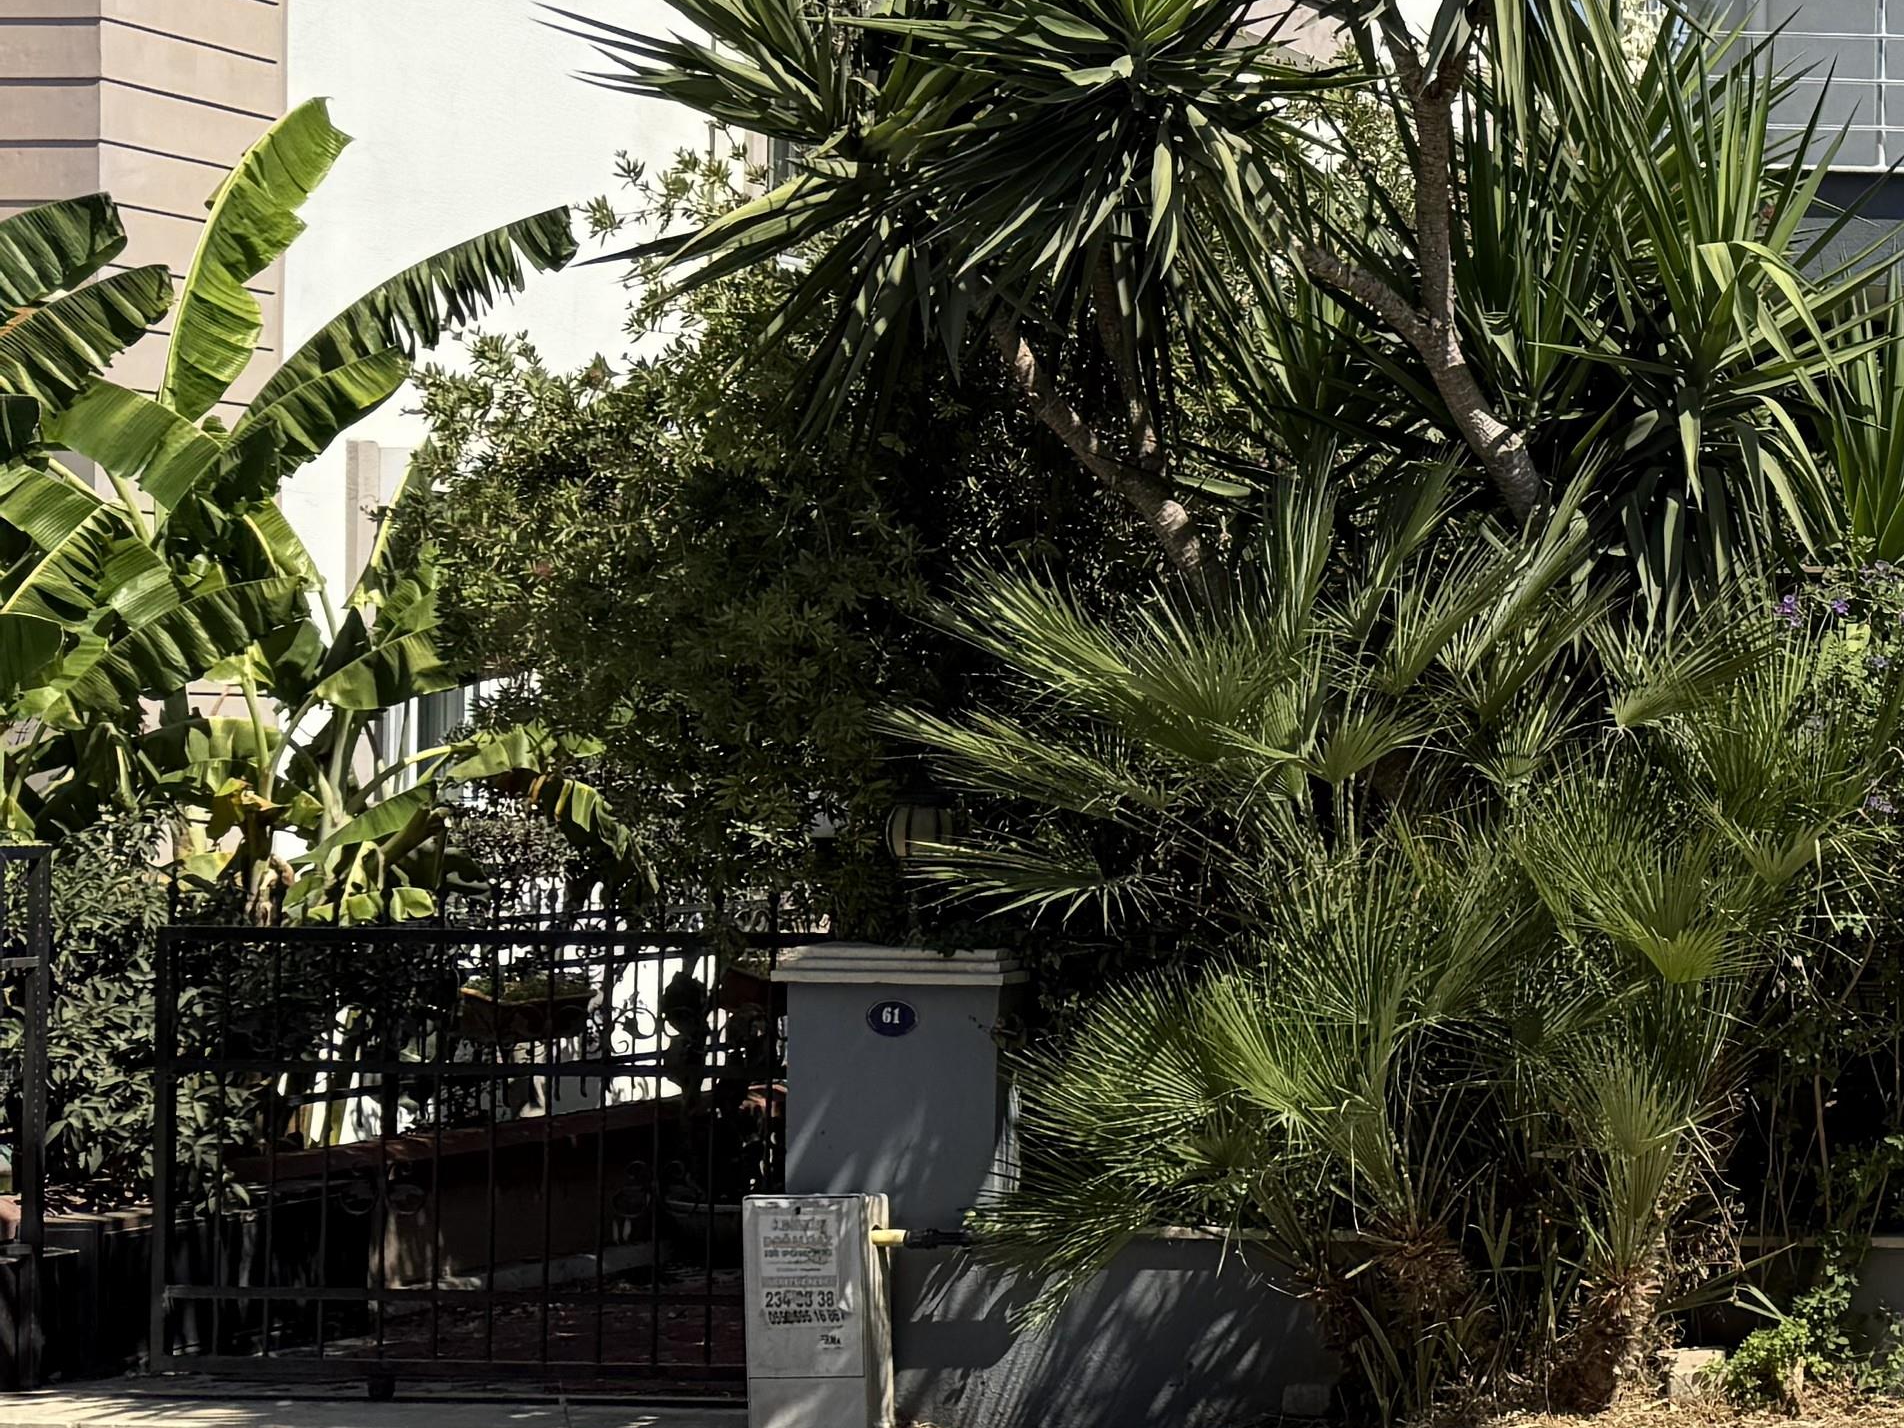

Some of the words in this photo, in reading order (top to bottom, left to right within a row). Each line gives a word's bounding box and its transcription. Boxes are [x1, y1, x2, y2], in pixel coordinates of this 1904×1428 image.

[882, 1007, 900, 1023] 61
[765, 1291, 791, 1308] 234
[817, 1291, 834, 1307] 38
